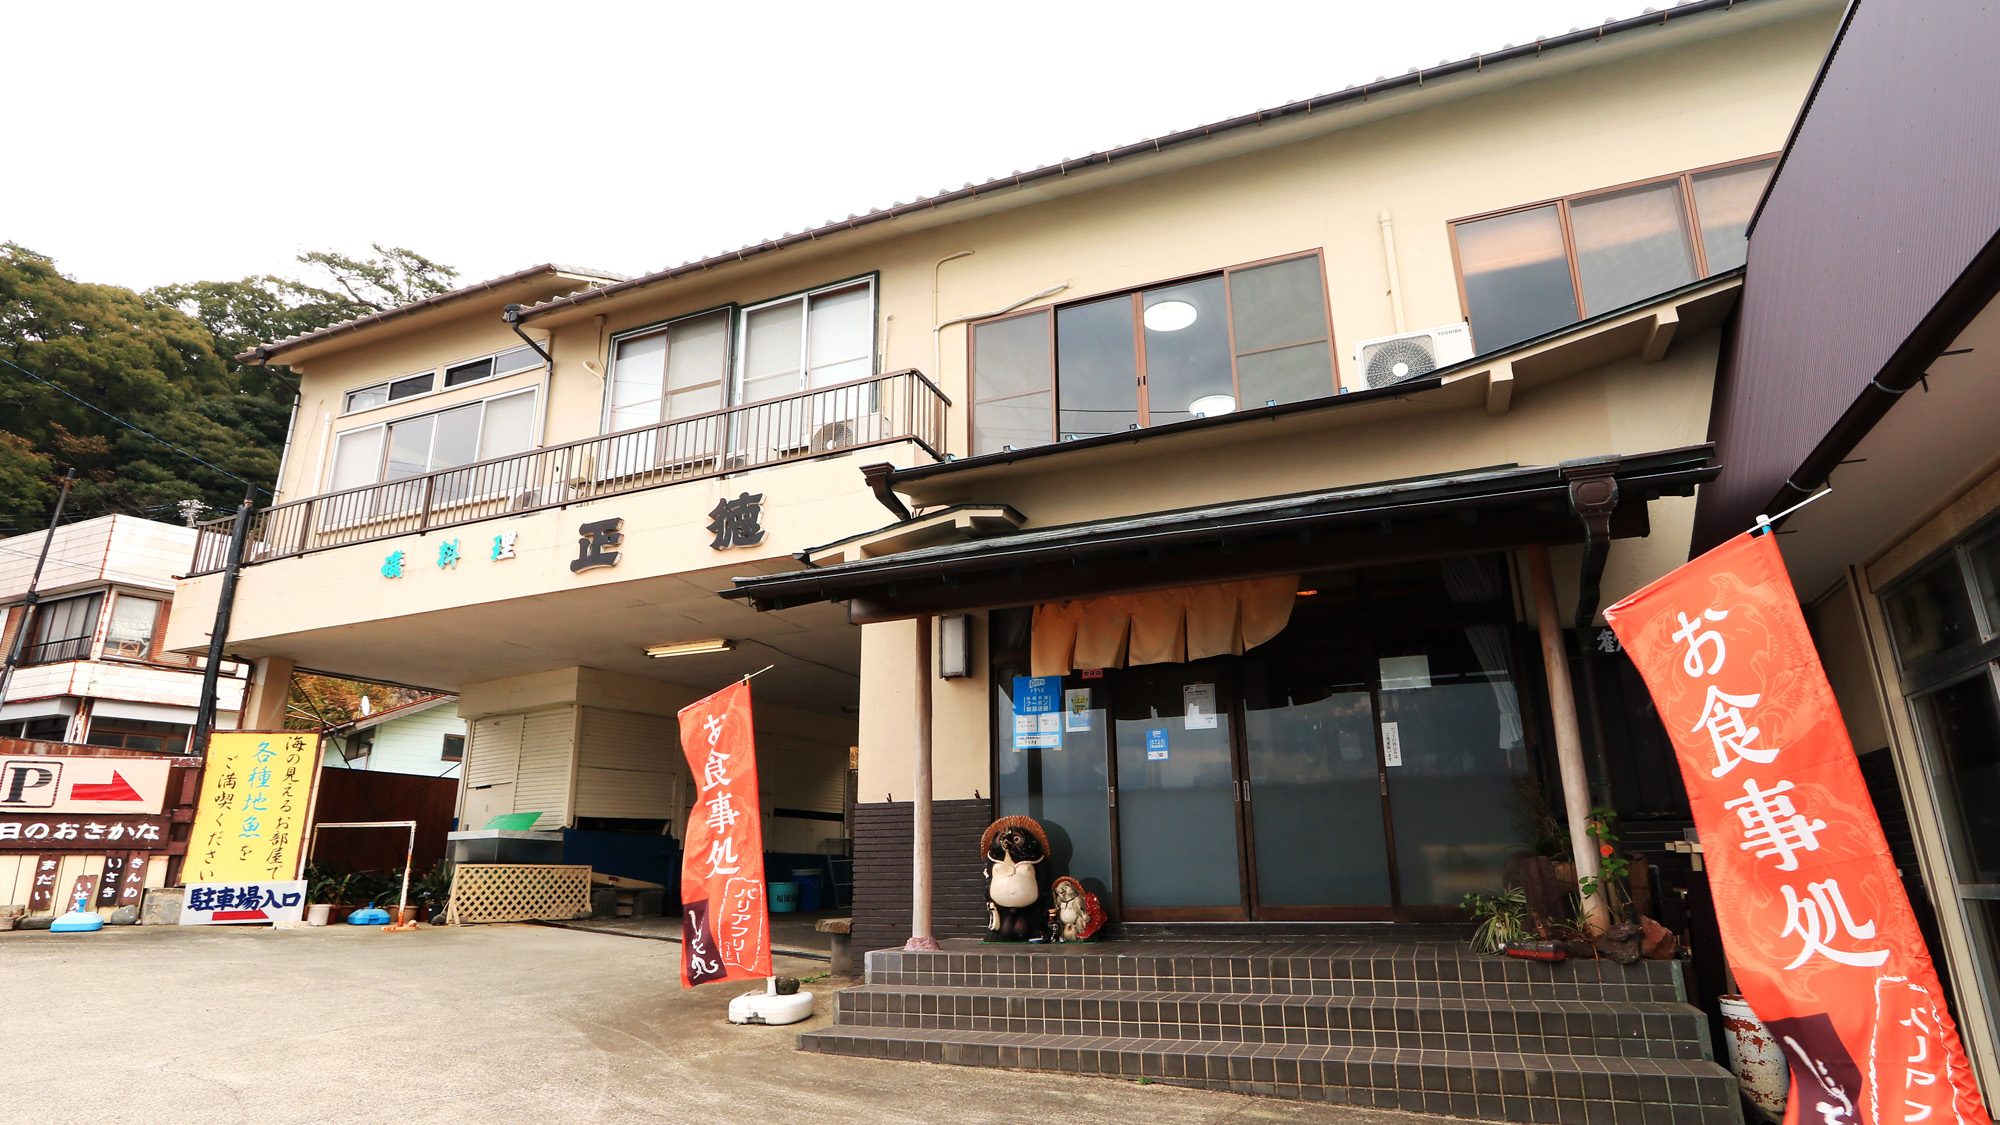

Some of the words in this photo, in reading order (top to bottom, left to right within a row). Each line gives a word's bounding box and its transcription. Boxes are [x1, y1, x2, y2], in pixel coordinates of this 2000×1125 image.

[1437, 328, 1462, 336] TOSHIBA
[1, 767, 53, 803] P
[238, 740, 277, 861] 各種地魚を
[702, 714, 740, 879] お食事処
[1672, 608, 1890, 971] お食事処
[200, 755, 237, 881] ご満喫ください
[266, 736, 307, 880] 海の見えるお部屋で
[0, 822, 160, 841] 日のおさかな
[34, 859, 57, 900] まだい
[102, 858, 123, 898] いさき
[123, 857, 145, 898] きんめ
[187, 885, 302, 911] 駐車場入口
[731, 887, 758, 963] バリアフリー
